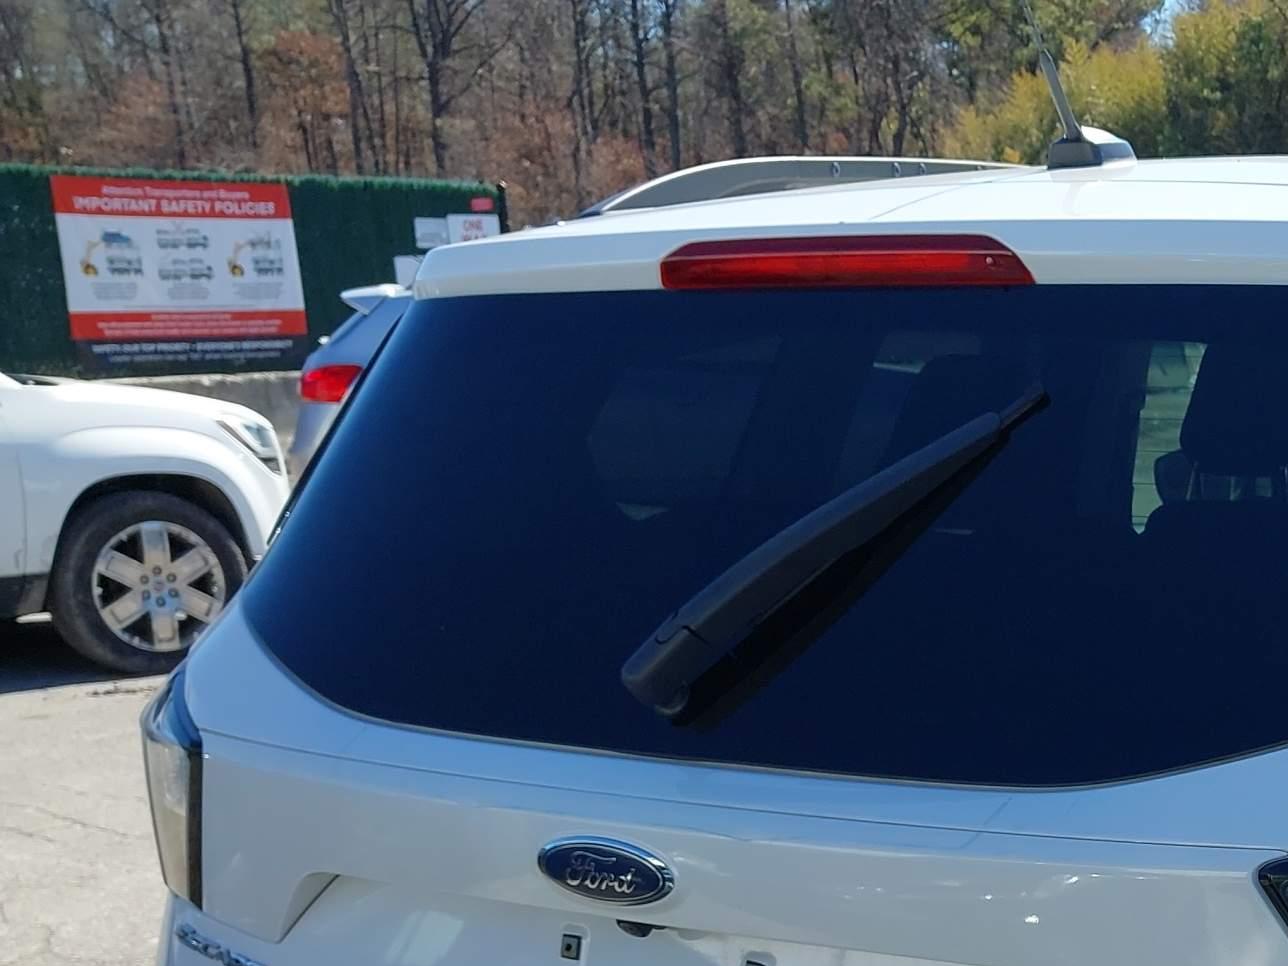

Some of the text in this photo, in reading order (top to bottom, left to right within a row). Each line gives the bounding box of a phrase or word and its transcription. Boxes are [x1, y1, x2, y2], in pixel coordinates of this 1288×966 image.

[72, 195, 275, 215] IMPORTANT SAFETY POLICIES
[565, 850, 641, 894] Ford
